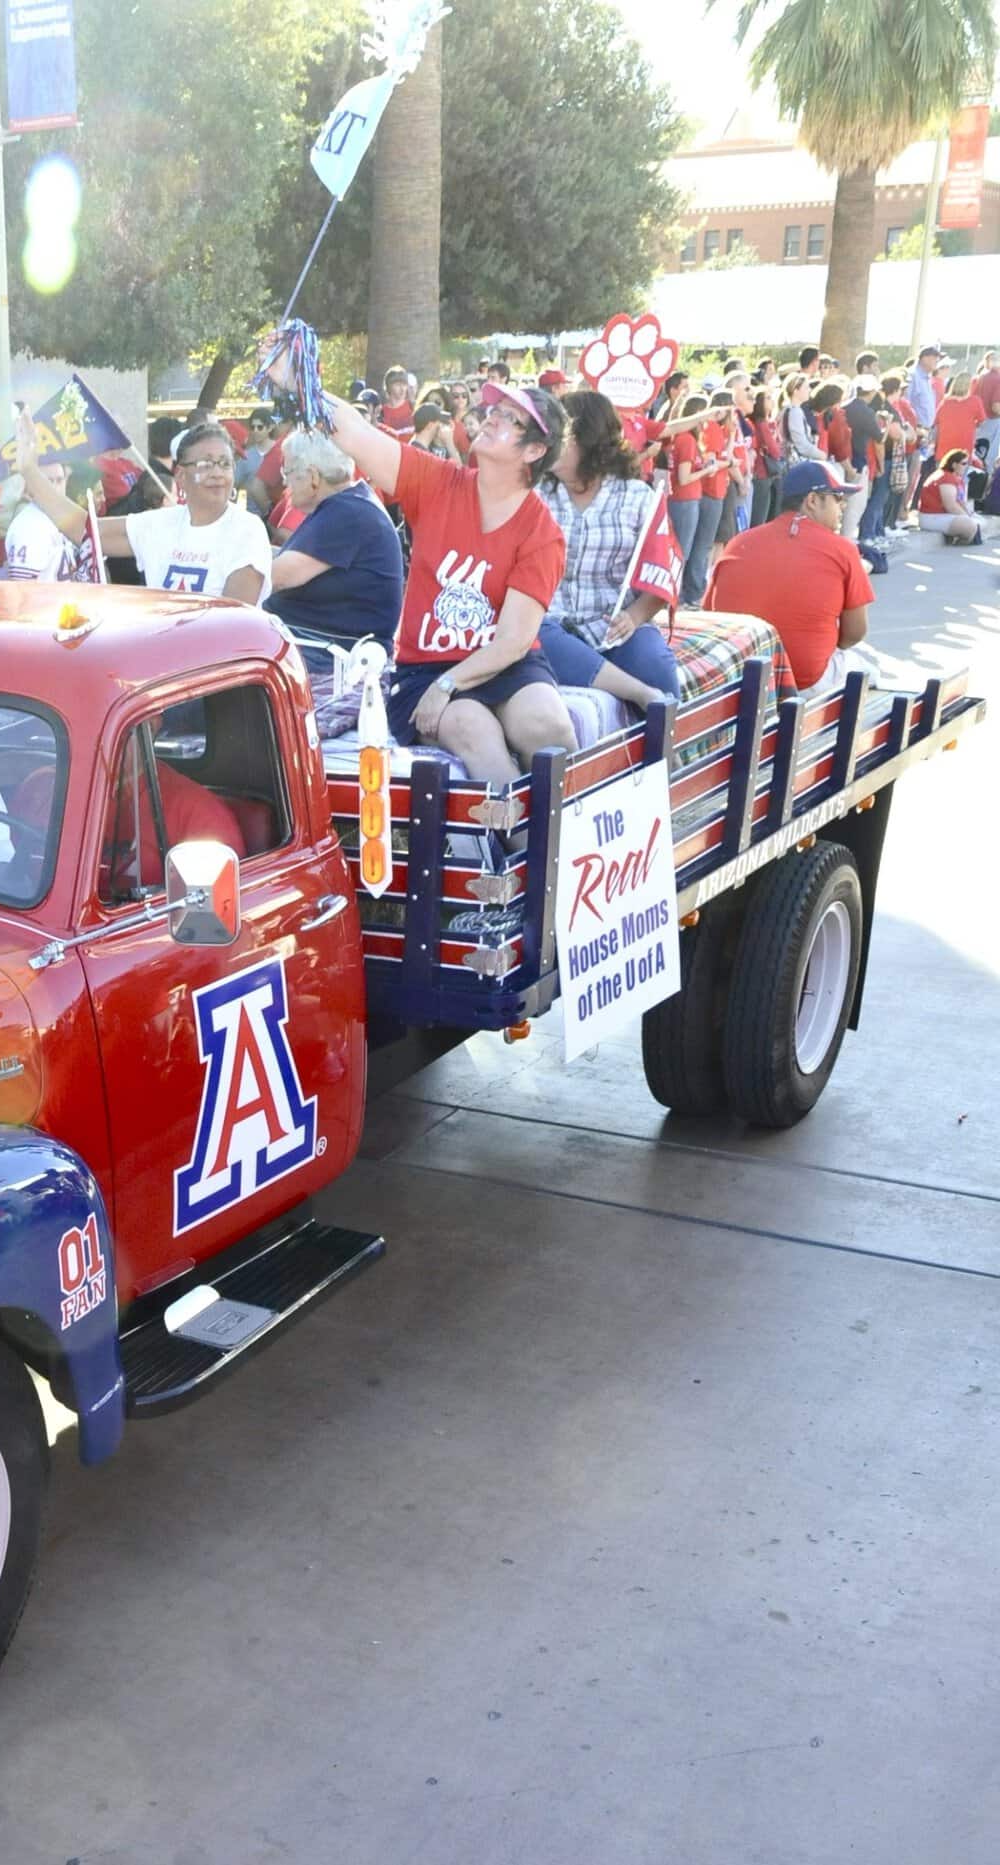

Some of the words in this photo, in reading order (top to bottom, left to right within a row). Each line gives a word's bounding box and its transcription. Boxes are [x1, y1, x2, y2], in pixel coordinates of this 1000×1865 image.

[593, 808, 625, 847] The
[694, 842, 769, 907] ARIZONA
[773, 797, 845, 856] WILDCATS
[568, 816, 661, 933] Real
[568, 928, 619, 981] House
[621, 898, 670, 952] Moms
[577, 984, 594, 1022] of
[596, 971, 622, 1010] the
[625, 960, 635, 992] U
[638, 949, 653, 984] of
[655, 941, 666, 976] A
[173, 954, 318, 1237] A
[58, 1212, 105, 1295] 01
[61, 1271, 106, 1331] FAN
